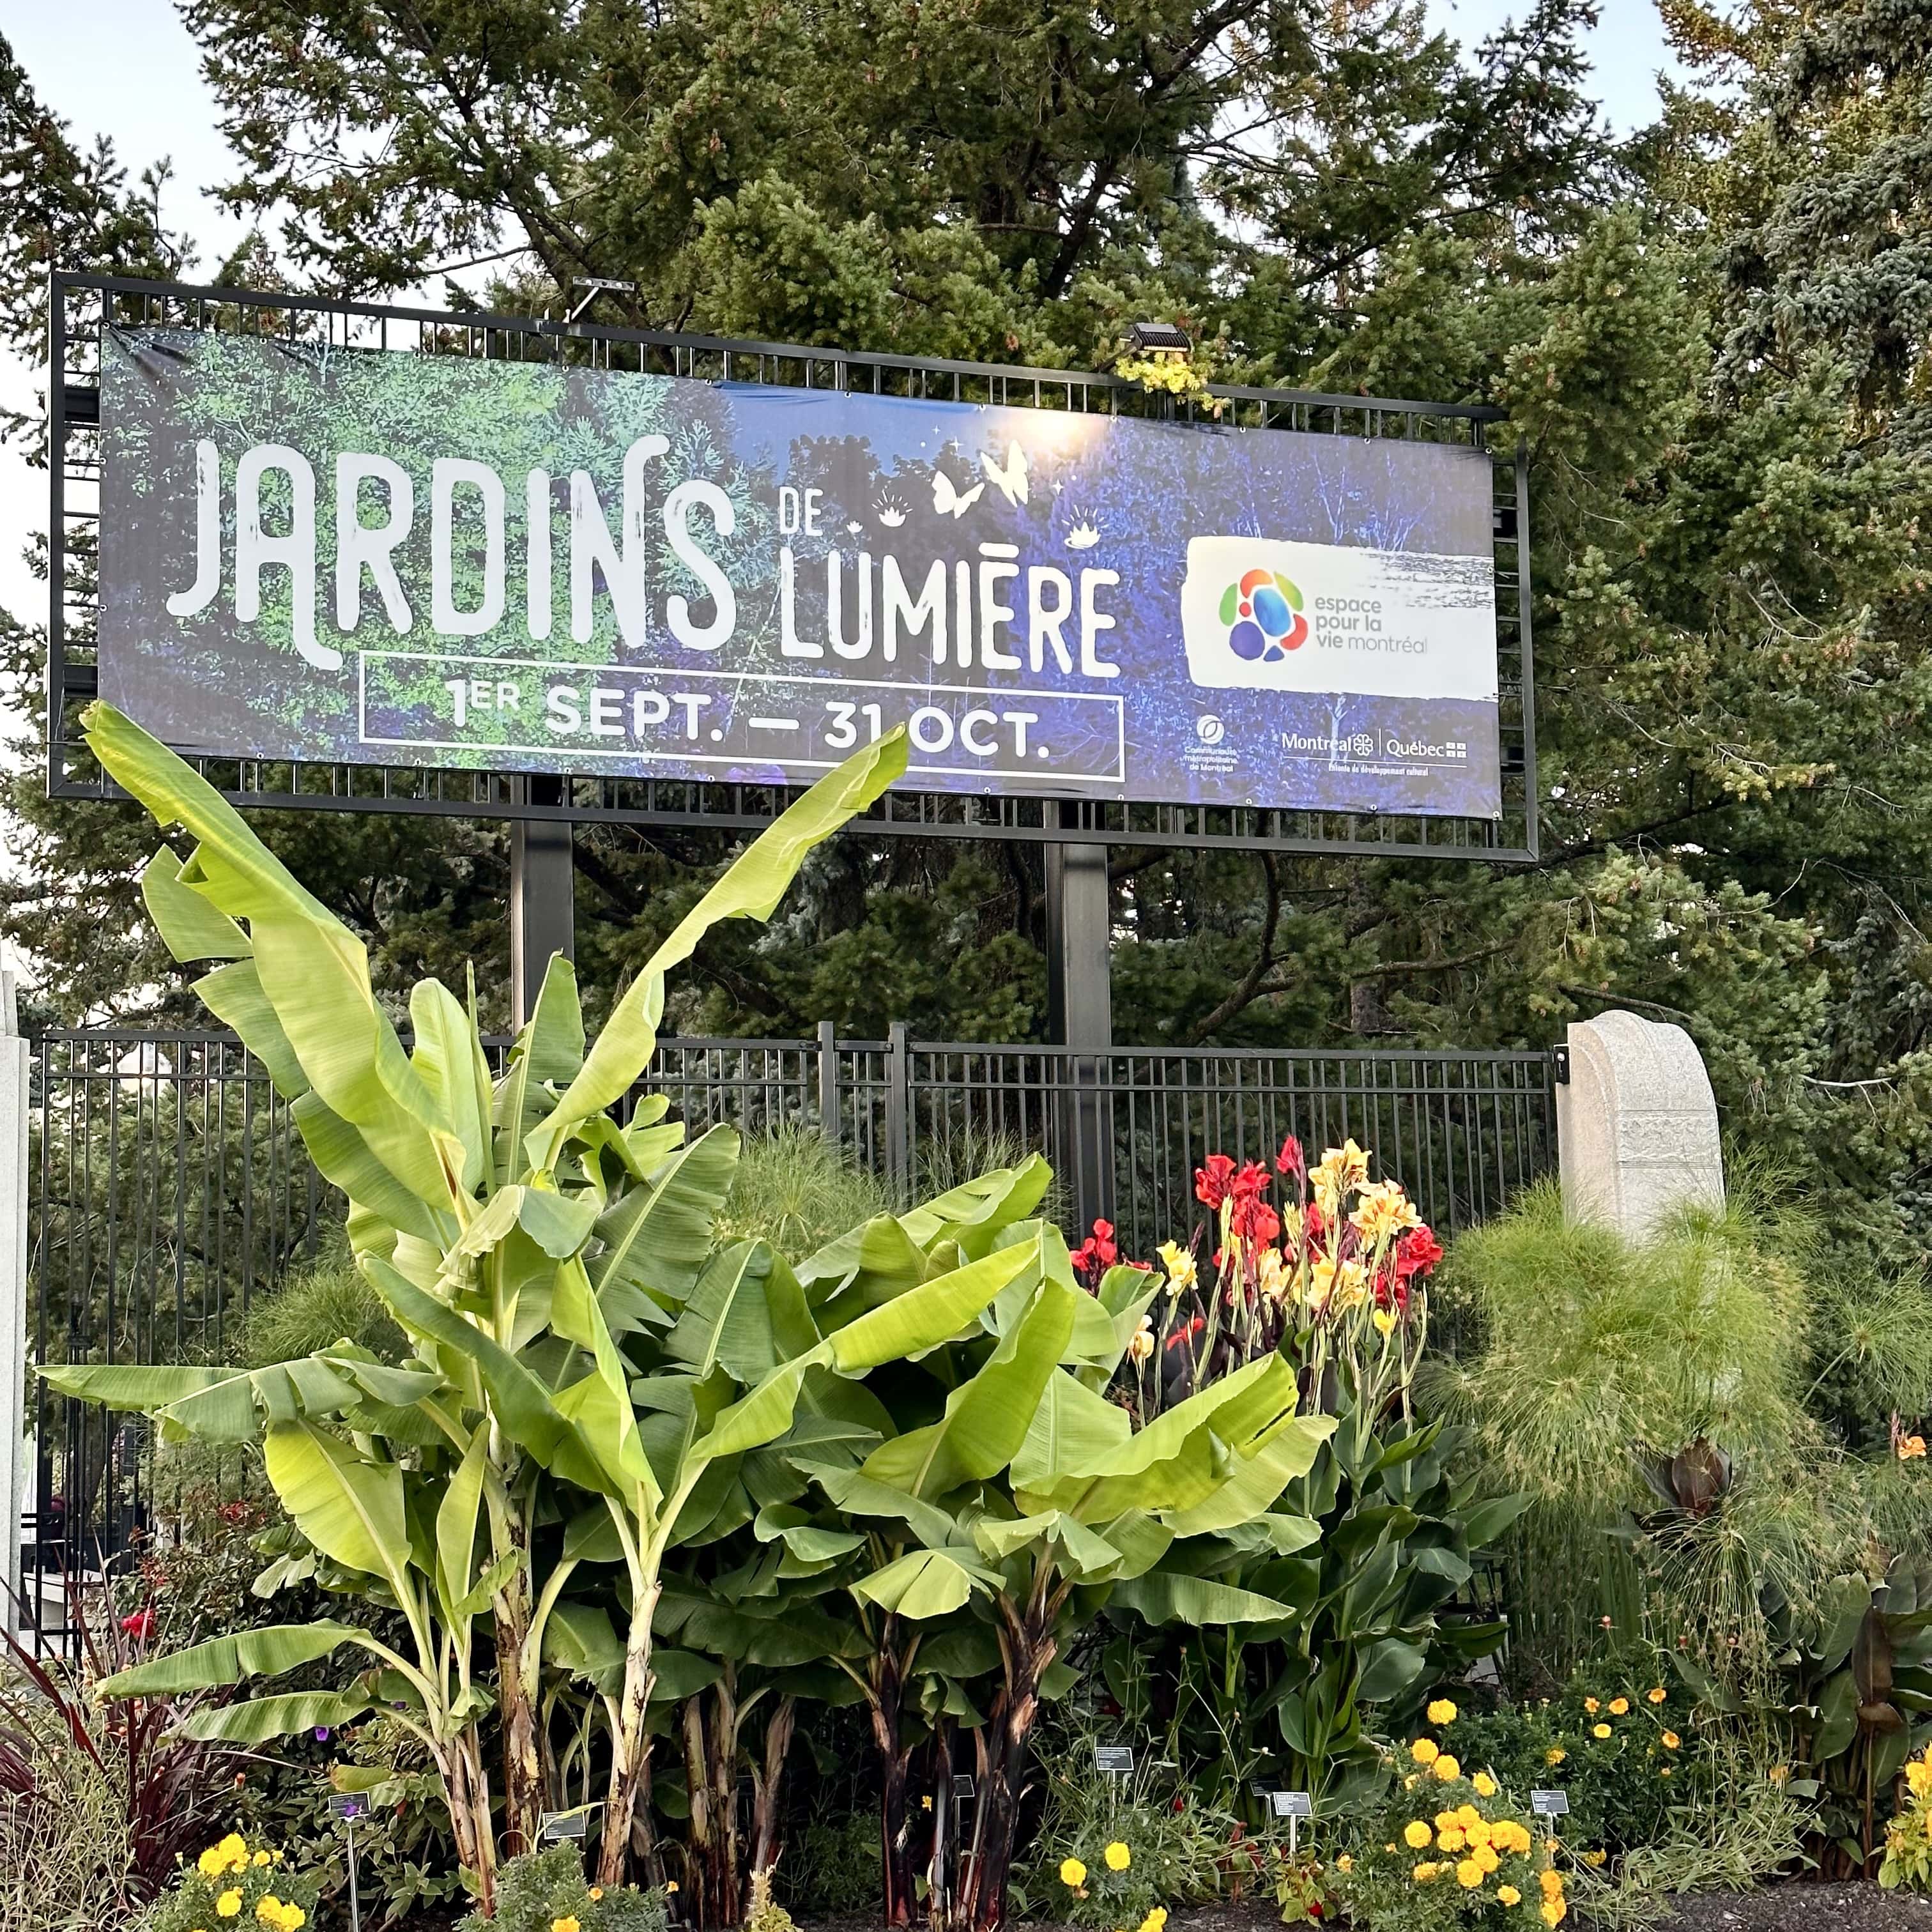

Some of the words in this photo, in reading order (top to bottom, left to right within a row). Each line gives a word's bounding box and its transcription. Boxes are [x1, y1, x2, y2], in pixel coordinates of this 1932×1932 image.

[779, 486, 823, 537] DE
[165, 434, 736, 670] JARDINS
[1315, 597, 1382, 614] espace
[1316, 615, 1360, 631] pour
[1365, 615, 1382, 631] la
[1317, 631, 1343, 648] vie
[1348, 636, 1427, 654] montréal
[545, 685, 723, 742] SEPT.
[825, 702, 882, 749] 31
[908, 707, 1050, 758] OCT.
[1282, 733, 1351, 752] Montréal
[1386, 739, 1445, 758] Québec
